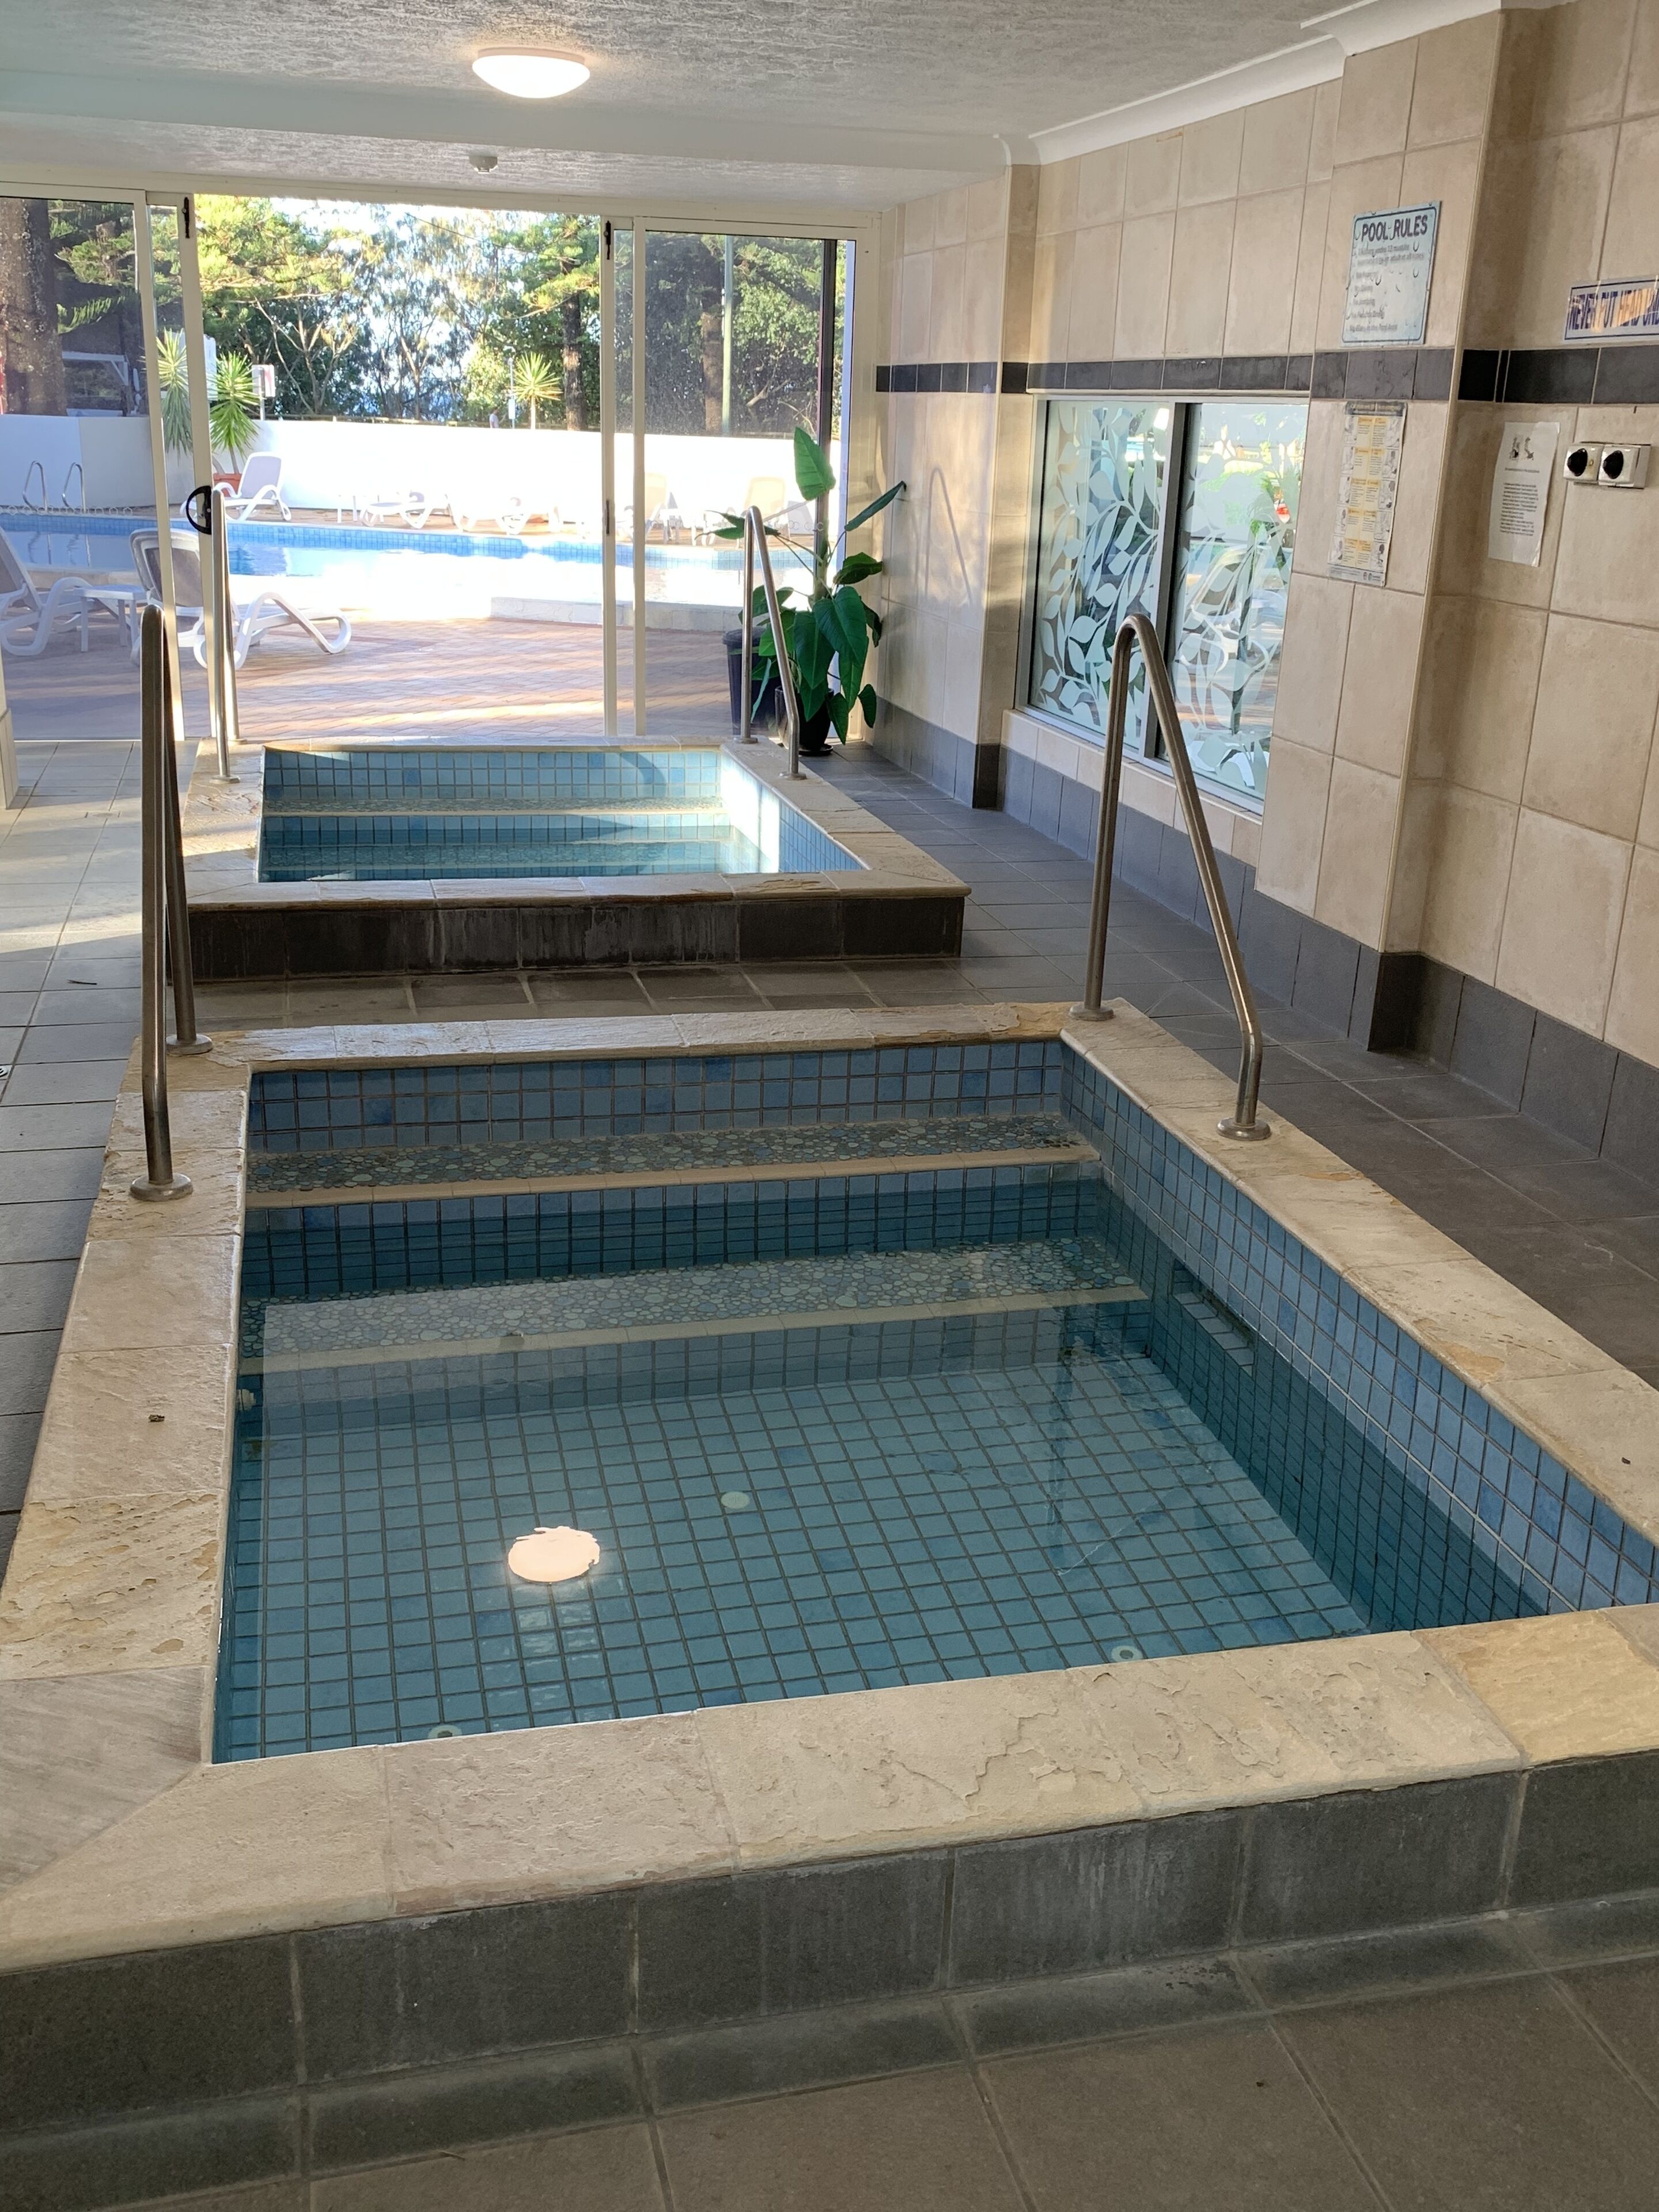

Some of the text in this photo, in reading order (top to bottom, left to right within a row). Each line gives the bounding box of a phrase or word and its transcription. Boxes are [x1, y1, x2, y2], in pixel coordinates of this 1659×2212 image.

[1361, 215, 1428, 242] POOL RULES
[1569, 293, 1599, 330] NEVER
[1598, 291, 1618, 328] PUT
[1617, 289, 1642, 327] HEAD
